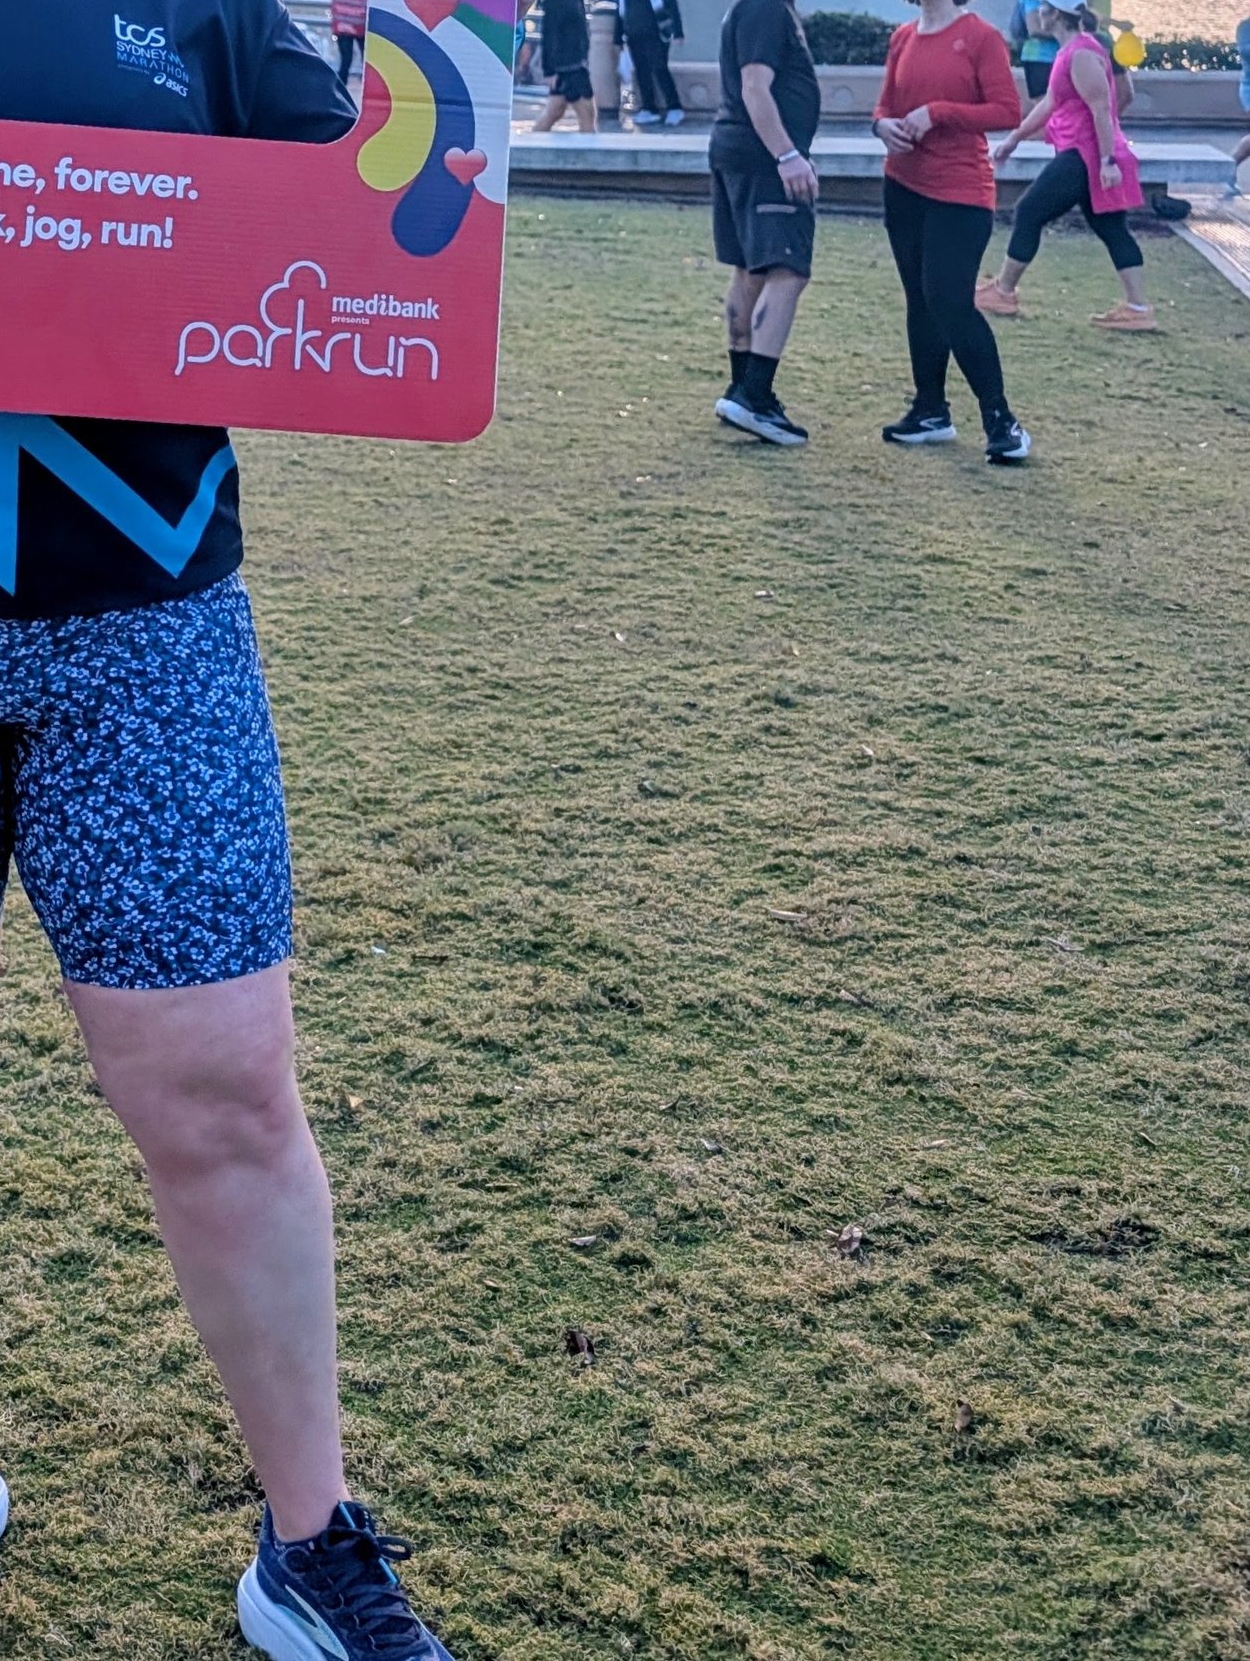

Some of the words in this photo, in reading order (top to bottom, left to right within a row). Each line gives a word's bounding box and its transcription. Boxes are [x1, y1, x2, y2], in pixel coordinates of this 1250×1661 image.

[113, 13, 166, 47] tcs
[116, 40, 167, 60] SYDNEY
[116, 51, 190, 84] MARATHON
[54, 156, 199, 201] forever.
[20, 205, 93, 251] jog,
[100, 216, 174, 249] run!
[174, 260, 440, 380] parkrun
[331, 293, 440, 320] medibank
[331, 315, 371, 326] presents
